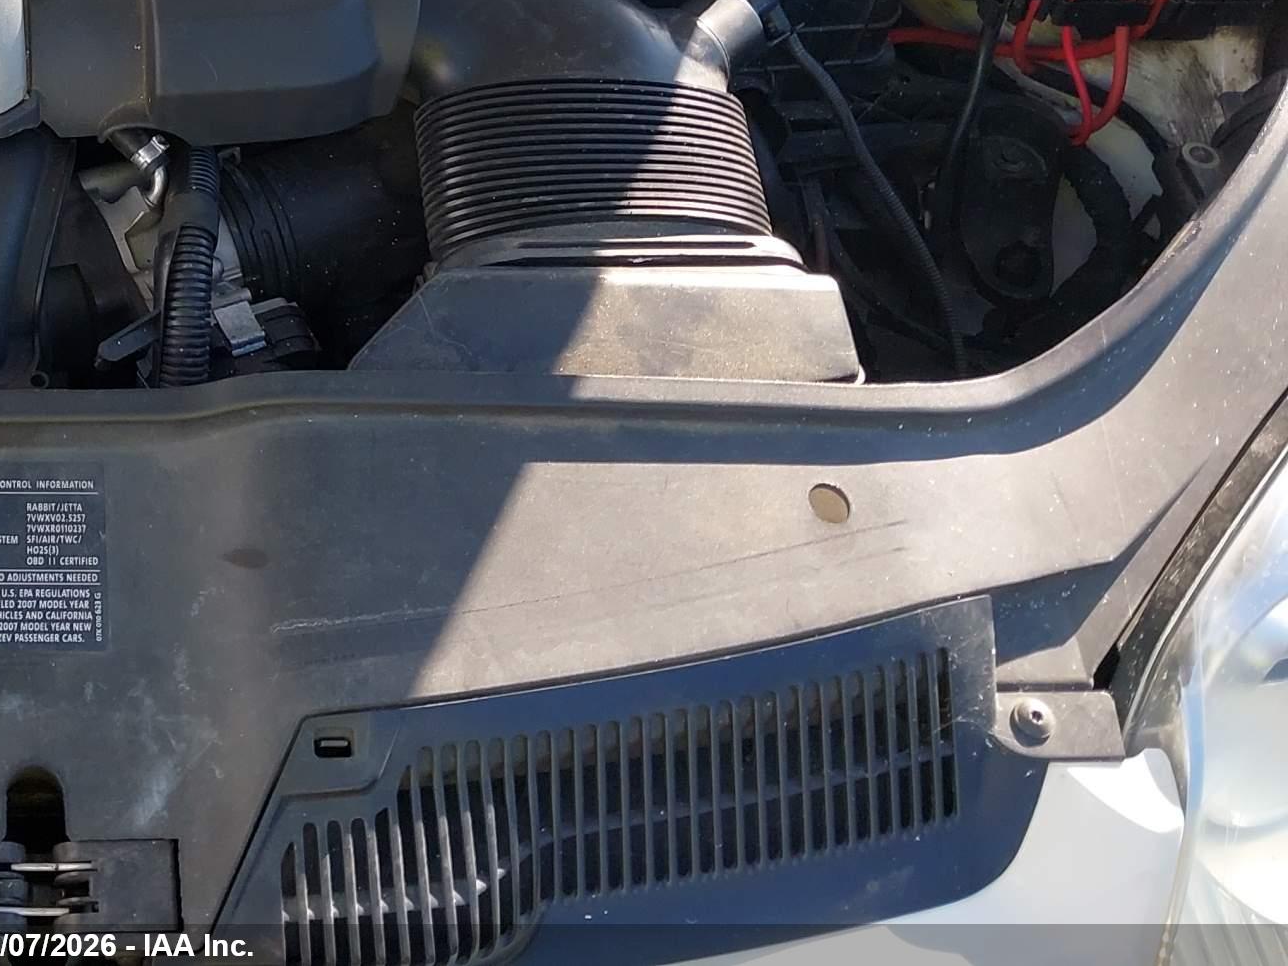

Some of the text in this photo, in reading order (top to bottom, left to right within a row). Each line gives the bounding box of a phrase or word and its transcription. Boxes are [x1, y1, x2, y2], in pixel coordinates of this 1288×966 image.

[37, 481, 94, 489] INFORMATION
[27, 503, 82, 512] RABBIT/JETTA
[27, 535, 82, 544] SFI/AIR/TWC/
[27, 557, 44, 565] OBD
[60, 557, 98, 565] CERTIFIED
[7, 573, 64, 582] ADJUSTMENTS
[66, 573, 98, 582] NEEDED
[2, 589, 17, 598] U.S.
[20, 589, 33, 597] EPA
[35, 589, 90, 598] REGULATIONS
[17, 600, 36, 609] 2007
[39, 600, 67, 609] MODEL
[69, 600, 89, 609] YEAR
[25, 611, 43, 620] AND
[46, 611, 93, 620] CALIFORNIA
[0, 622, 18, 631] 2007
[20, 622, 48, 631] MODEL
[51, 622, 71, 631] YEAR
[73, 623, 91, 631] NEW
[15, 634, 59, 642] PASSENGER
[62, 634, 85, 642] CARS.
